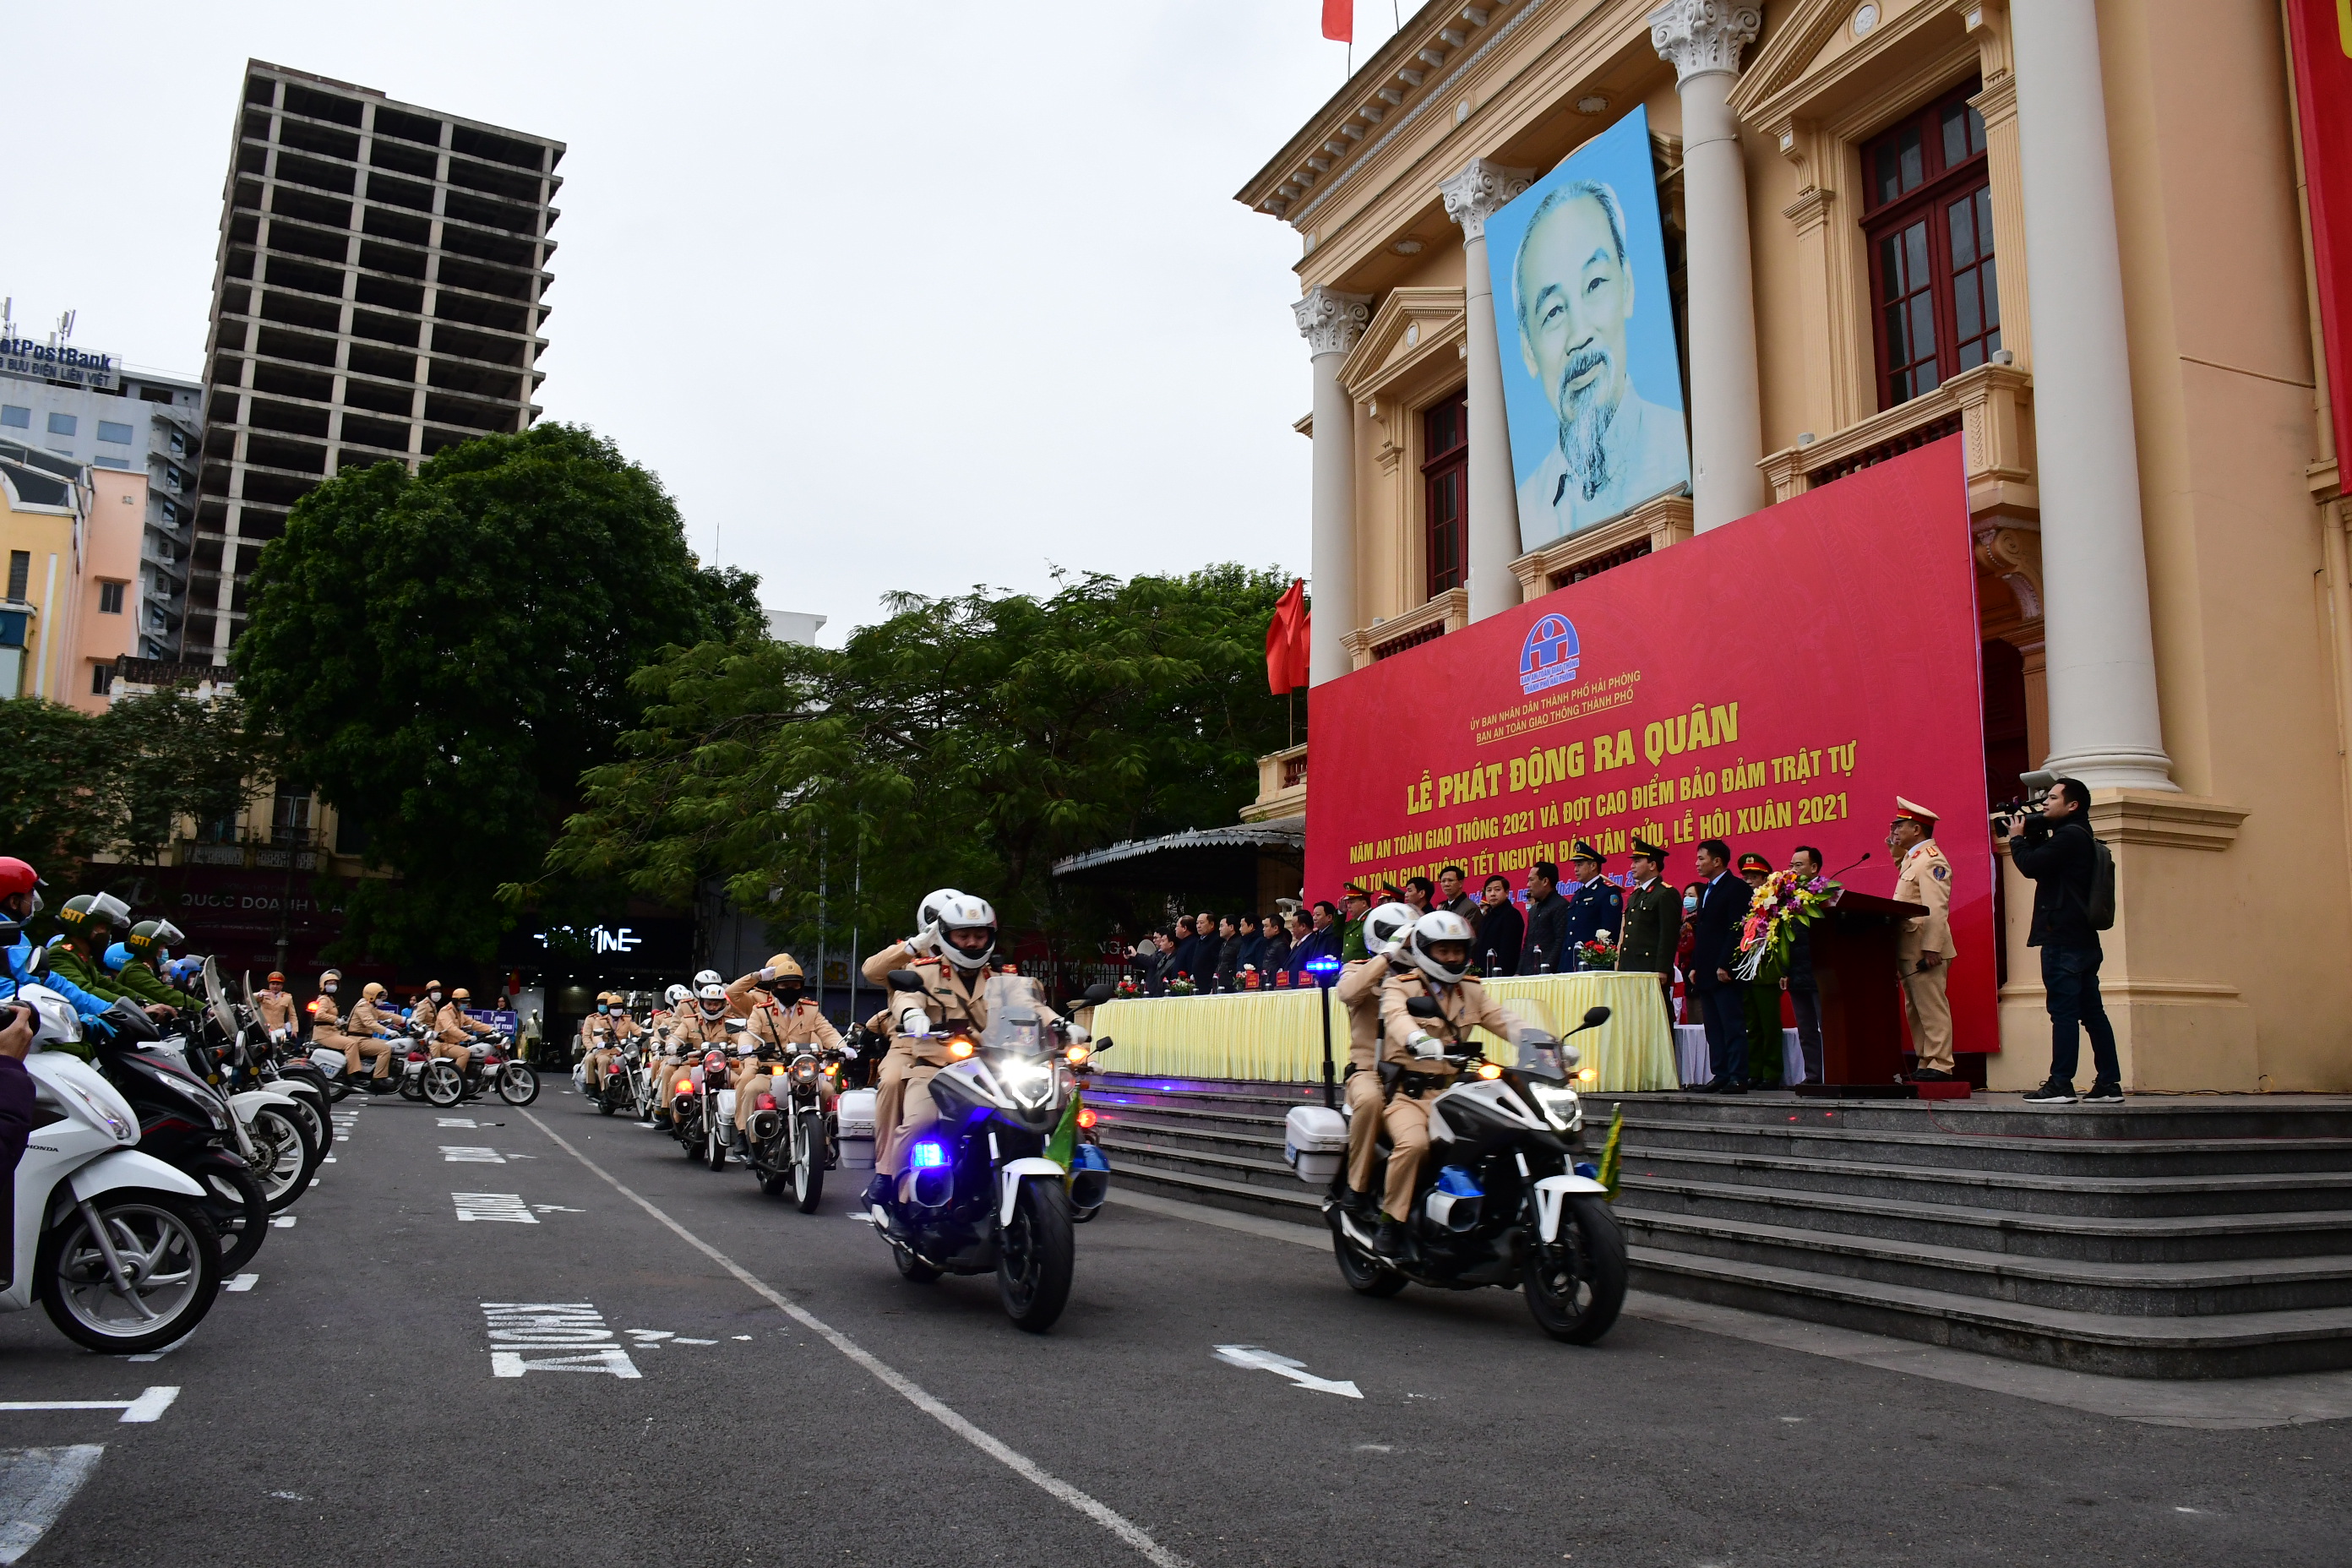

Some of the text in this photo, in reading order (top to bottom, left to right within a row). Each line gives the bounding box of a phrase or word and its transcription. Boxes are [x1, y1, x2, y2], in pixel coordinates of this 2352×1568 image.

[1470, 670, 1641, 731] ỦY BAN NHÂN DÂN THÀNH PHỐ HẢI PHÒNG
[1476, 683, 1634, 743] BAN AN TOÀN GIAO THÔNG THÀNH PHỐ
[1407, 703, 1739, 816] LỄ PHÁT ĐỘNG RA QUÂN
[1349, 739, 1857, 864] NĂM AN TOÀN GIAO THÔNG 2021 VÀ ĐỢT CAO ĐIỂM BẢO ĐẢM TRẬT TỰ
[1353, 874, 1367, 891] AN
[1369, 868, 1397, 891] TOÀN
[1399, 864, 1426, 888] GIAO
[1472, 847, 1494, 875] TẾT
[1498, 840, 1555, 874] NGUYÊN
[1594, 827, 1625, 856] TÂN
[1674, 808, 1694, 844] LỄ
[1700, 807, 1731, 841] HỘI
[1736, 799, 1792, 835] XUÂN
[1798, 792, 1848, 825] 2021
[60, 907, 86, 924] CSTT
[129, 934, 152, 947] CSTT
